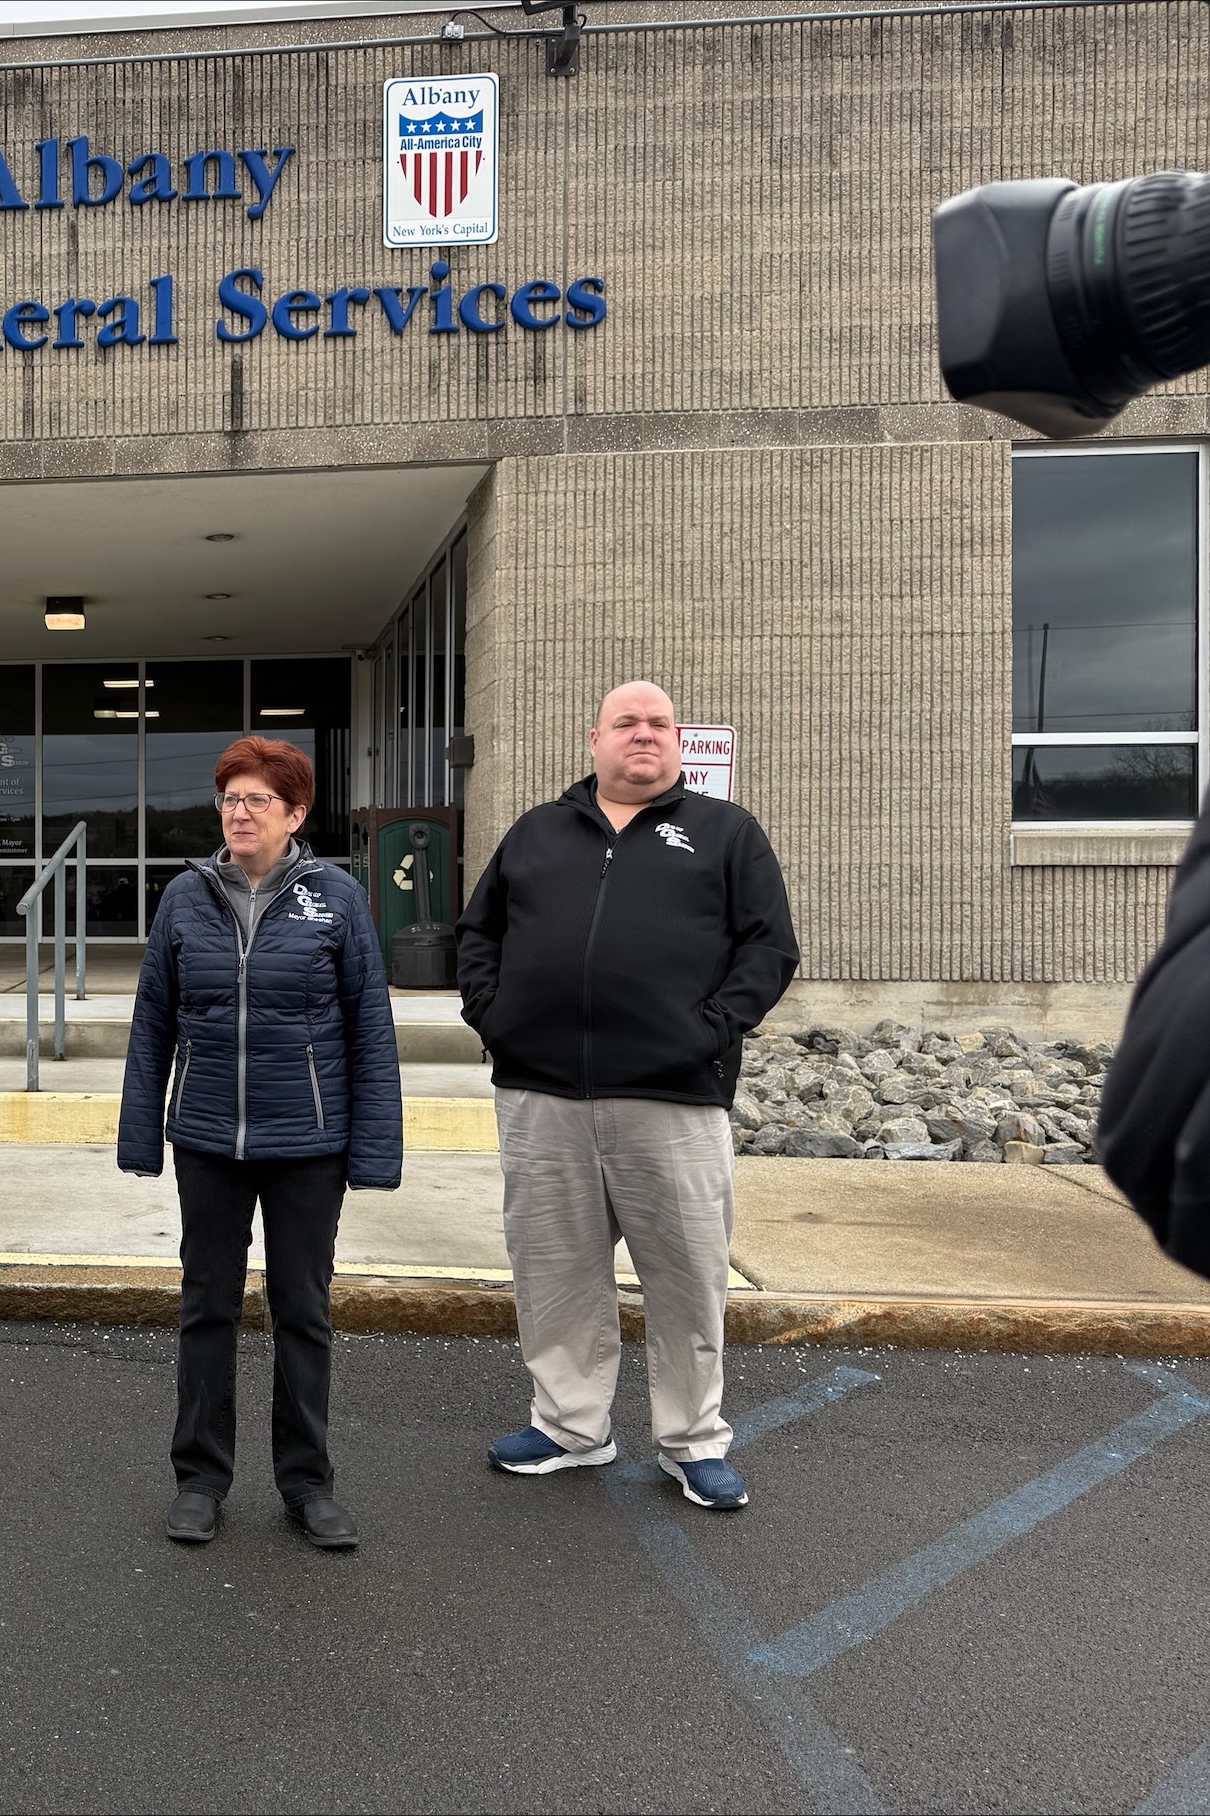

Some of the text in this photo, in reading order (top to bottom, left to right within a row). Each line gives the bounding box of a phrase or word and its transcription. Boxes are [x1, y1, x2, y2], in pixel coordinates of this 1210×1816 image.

[402, 85, 481, 109] Albany
[400, 135, 482, 151] All-America City
[393, 222, 488, 238] New York's Capital
[217, 261, 607, 343] Services
[681, 739, 731, 755] PARKING
[10, 777, 20, 786] of
[2, 839, 22, 847] Mayor
